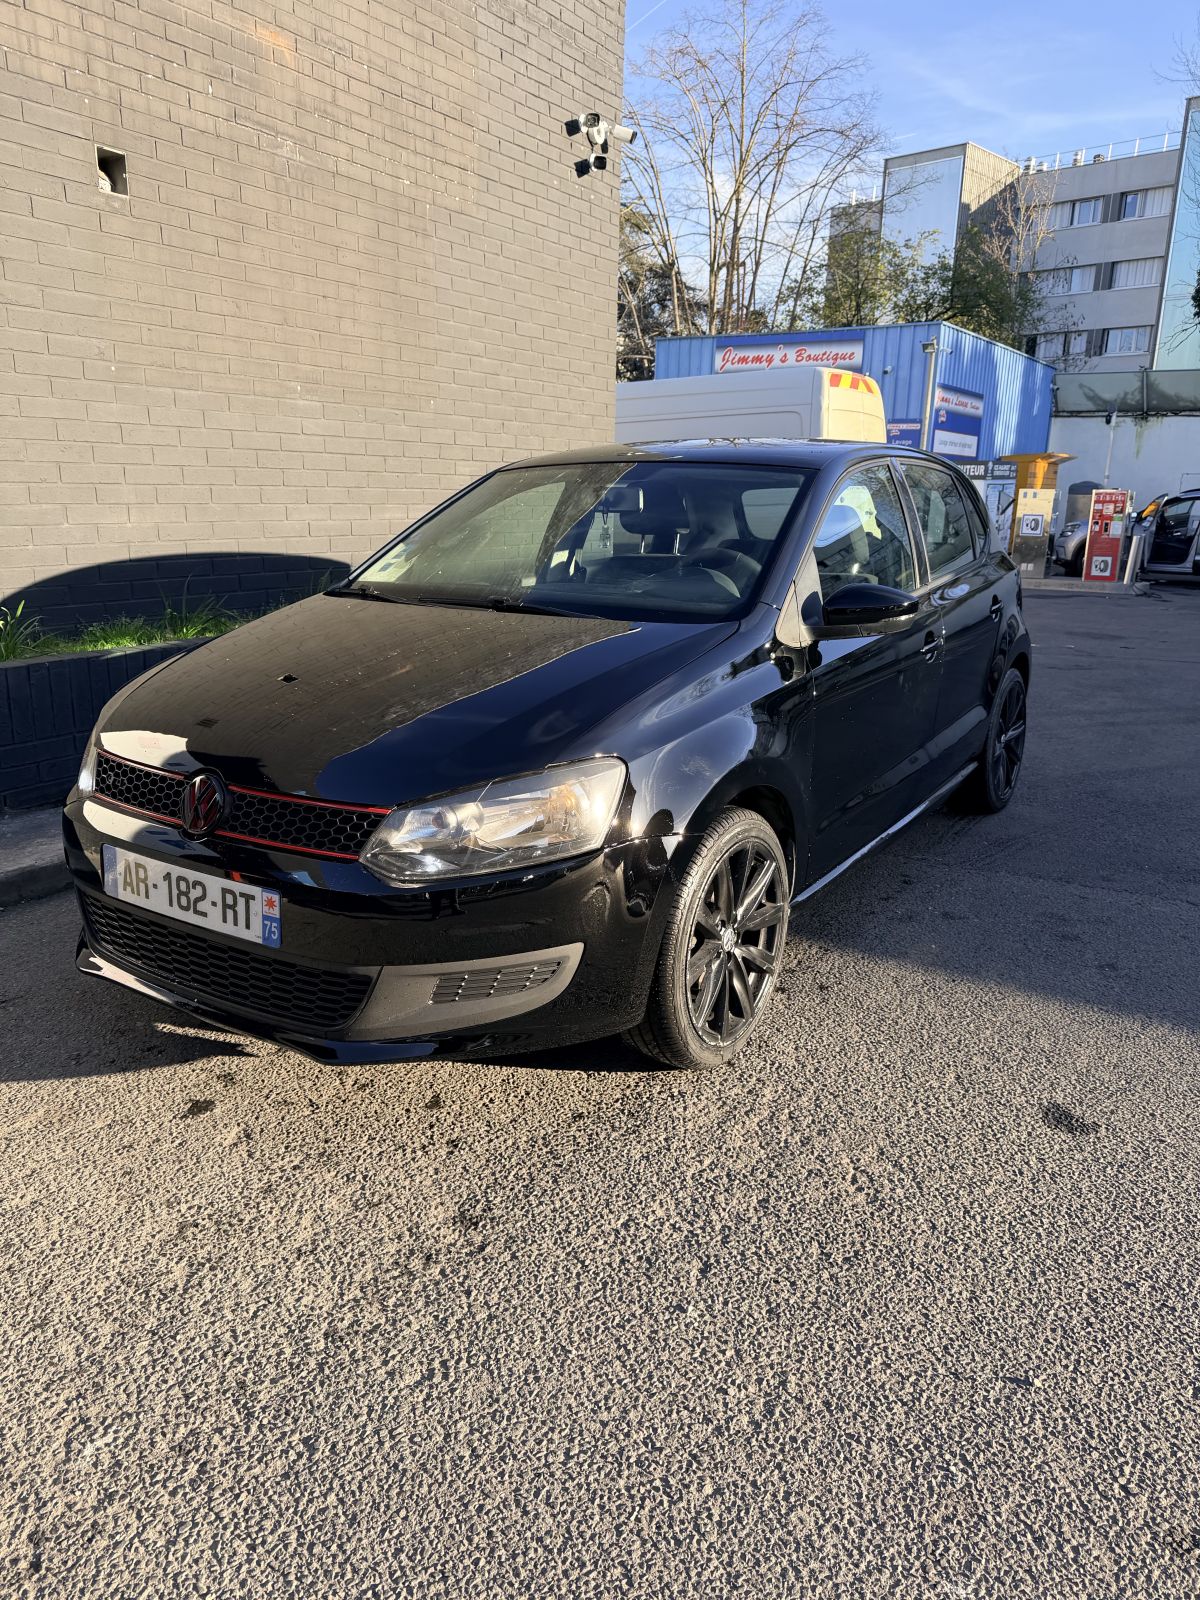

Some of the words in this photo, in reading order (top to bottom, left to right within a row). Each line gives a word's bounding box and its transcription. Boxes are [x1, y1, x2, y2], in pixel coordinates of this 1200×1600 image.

[719, 344, 789, 373] Jimmy's
[794, 347, 856, 367] Boutique
[122, 858, 256, 931] AR-182-RT
[263, 920, 278, 940] 75
